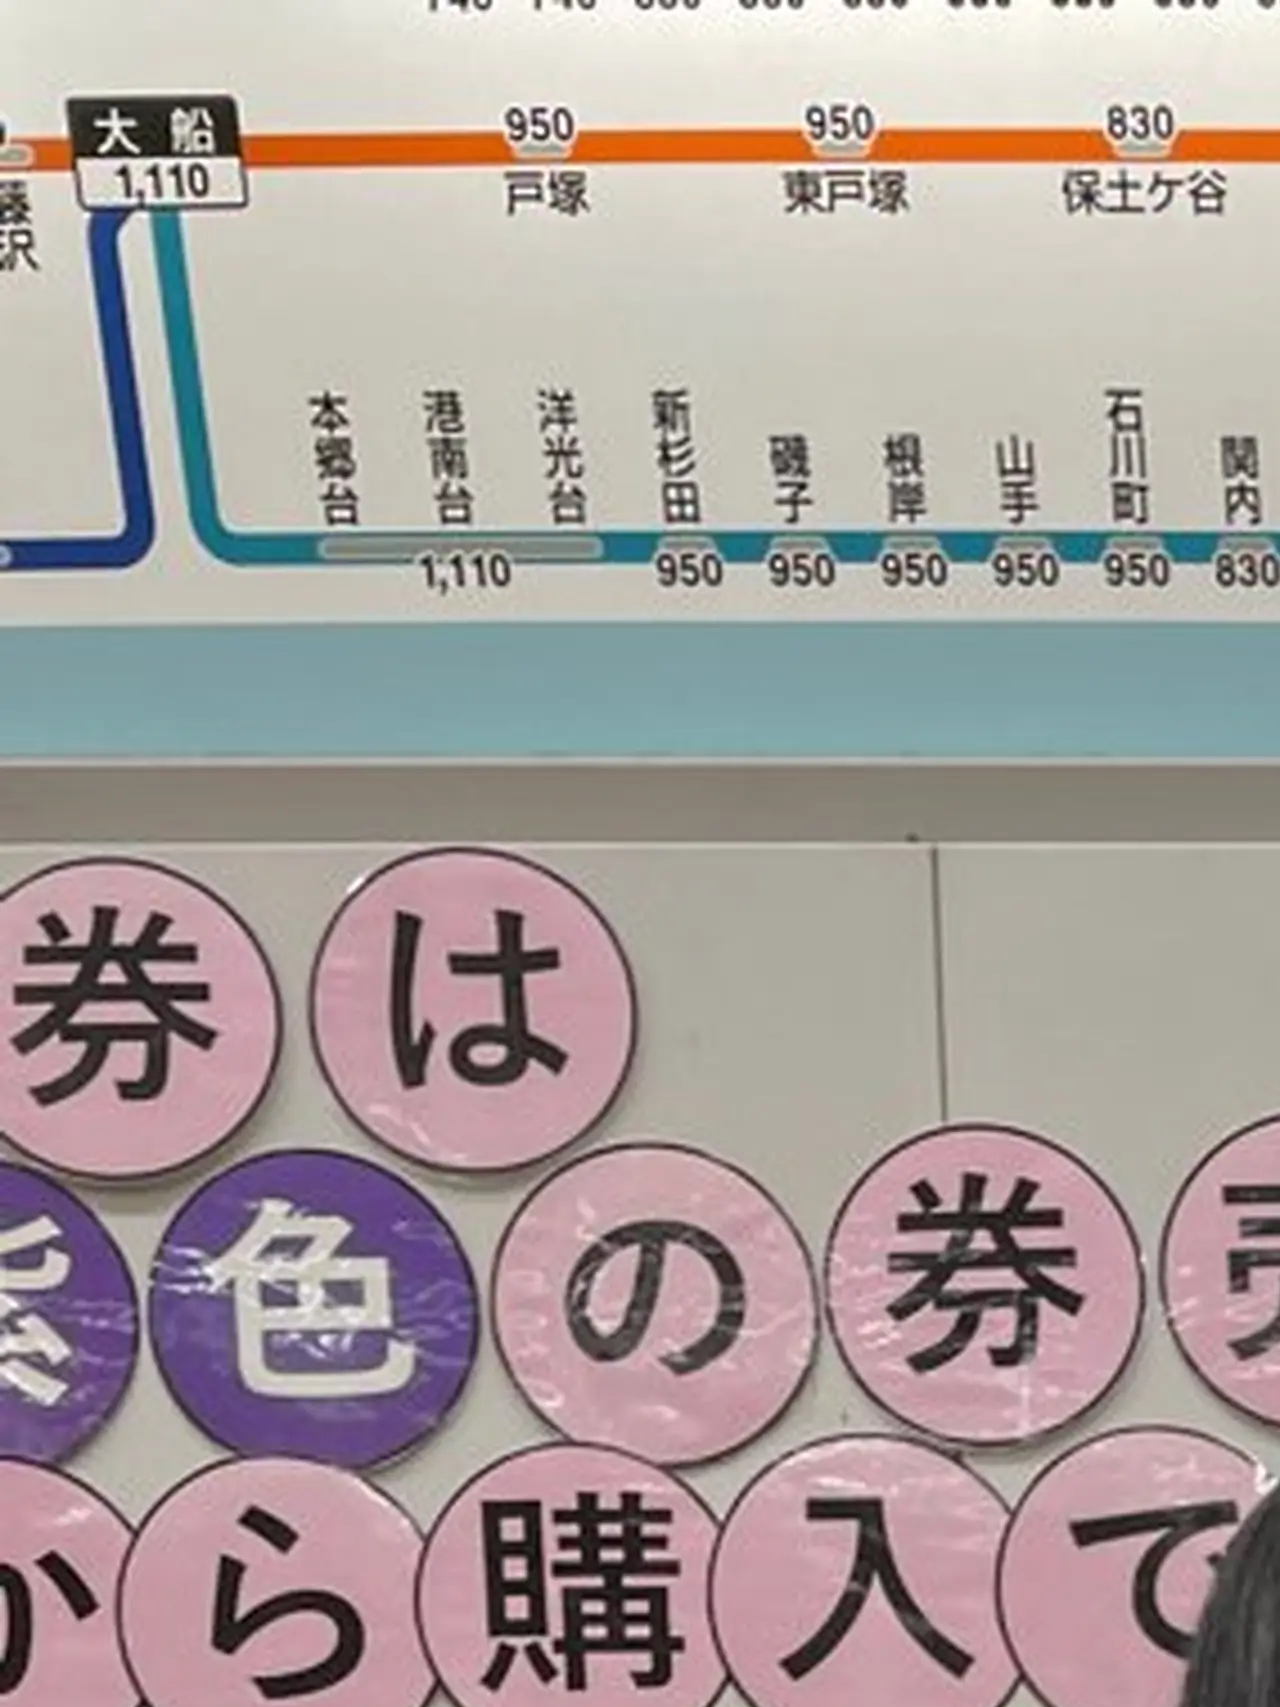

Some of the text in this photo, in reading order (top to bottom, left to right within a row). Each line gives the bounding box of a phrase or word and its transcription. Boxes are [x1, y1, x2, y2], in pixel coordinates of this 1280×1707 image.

[95, 108, 216, 155] 大船
[504, 108, 574, 143] 950
[805, 105, 874, 141] 950
[1106, 105, 1174, 141] 830
[115, 165, 209, 206] 1,110
[503, 172, 589, 217] 戸塚
[782, 170, 910, 216] 東戸塚
[308, 392, 358, 526] 本郷台
[423, 390, 473, 525] 港南台
[537, 390, 587, 525] 洋光台
[652, 389, 700, 524] 新杉田
[883, 433, 928, 524] 根岸
[1105, 387, 1150, 525] 石川町
[769, 435, 813, 526] 磯子
[995, 434, 1040, 524] 山手
[1220, 434, 1263, 525] 関内
[420, 554, 511, 593] 1,110
[657, 553, 722, 588] 950
[769, 553, 835, 588] 950
[881, 553, 948, 588] 950
[992, 553, 1060, 588] 950
[1104, 553, 1170, 588] 950
[1216, 553, 1280, 588] 830
